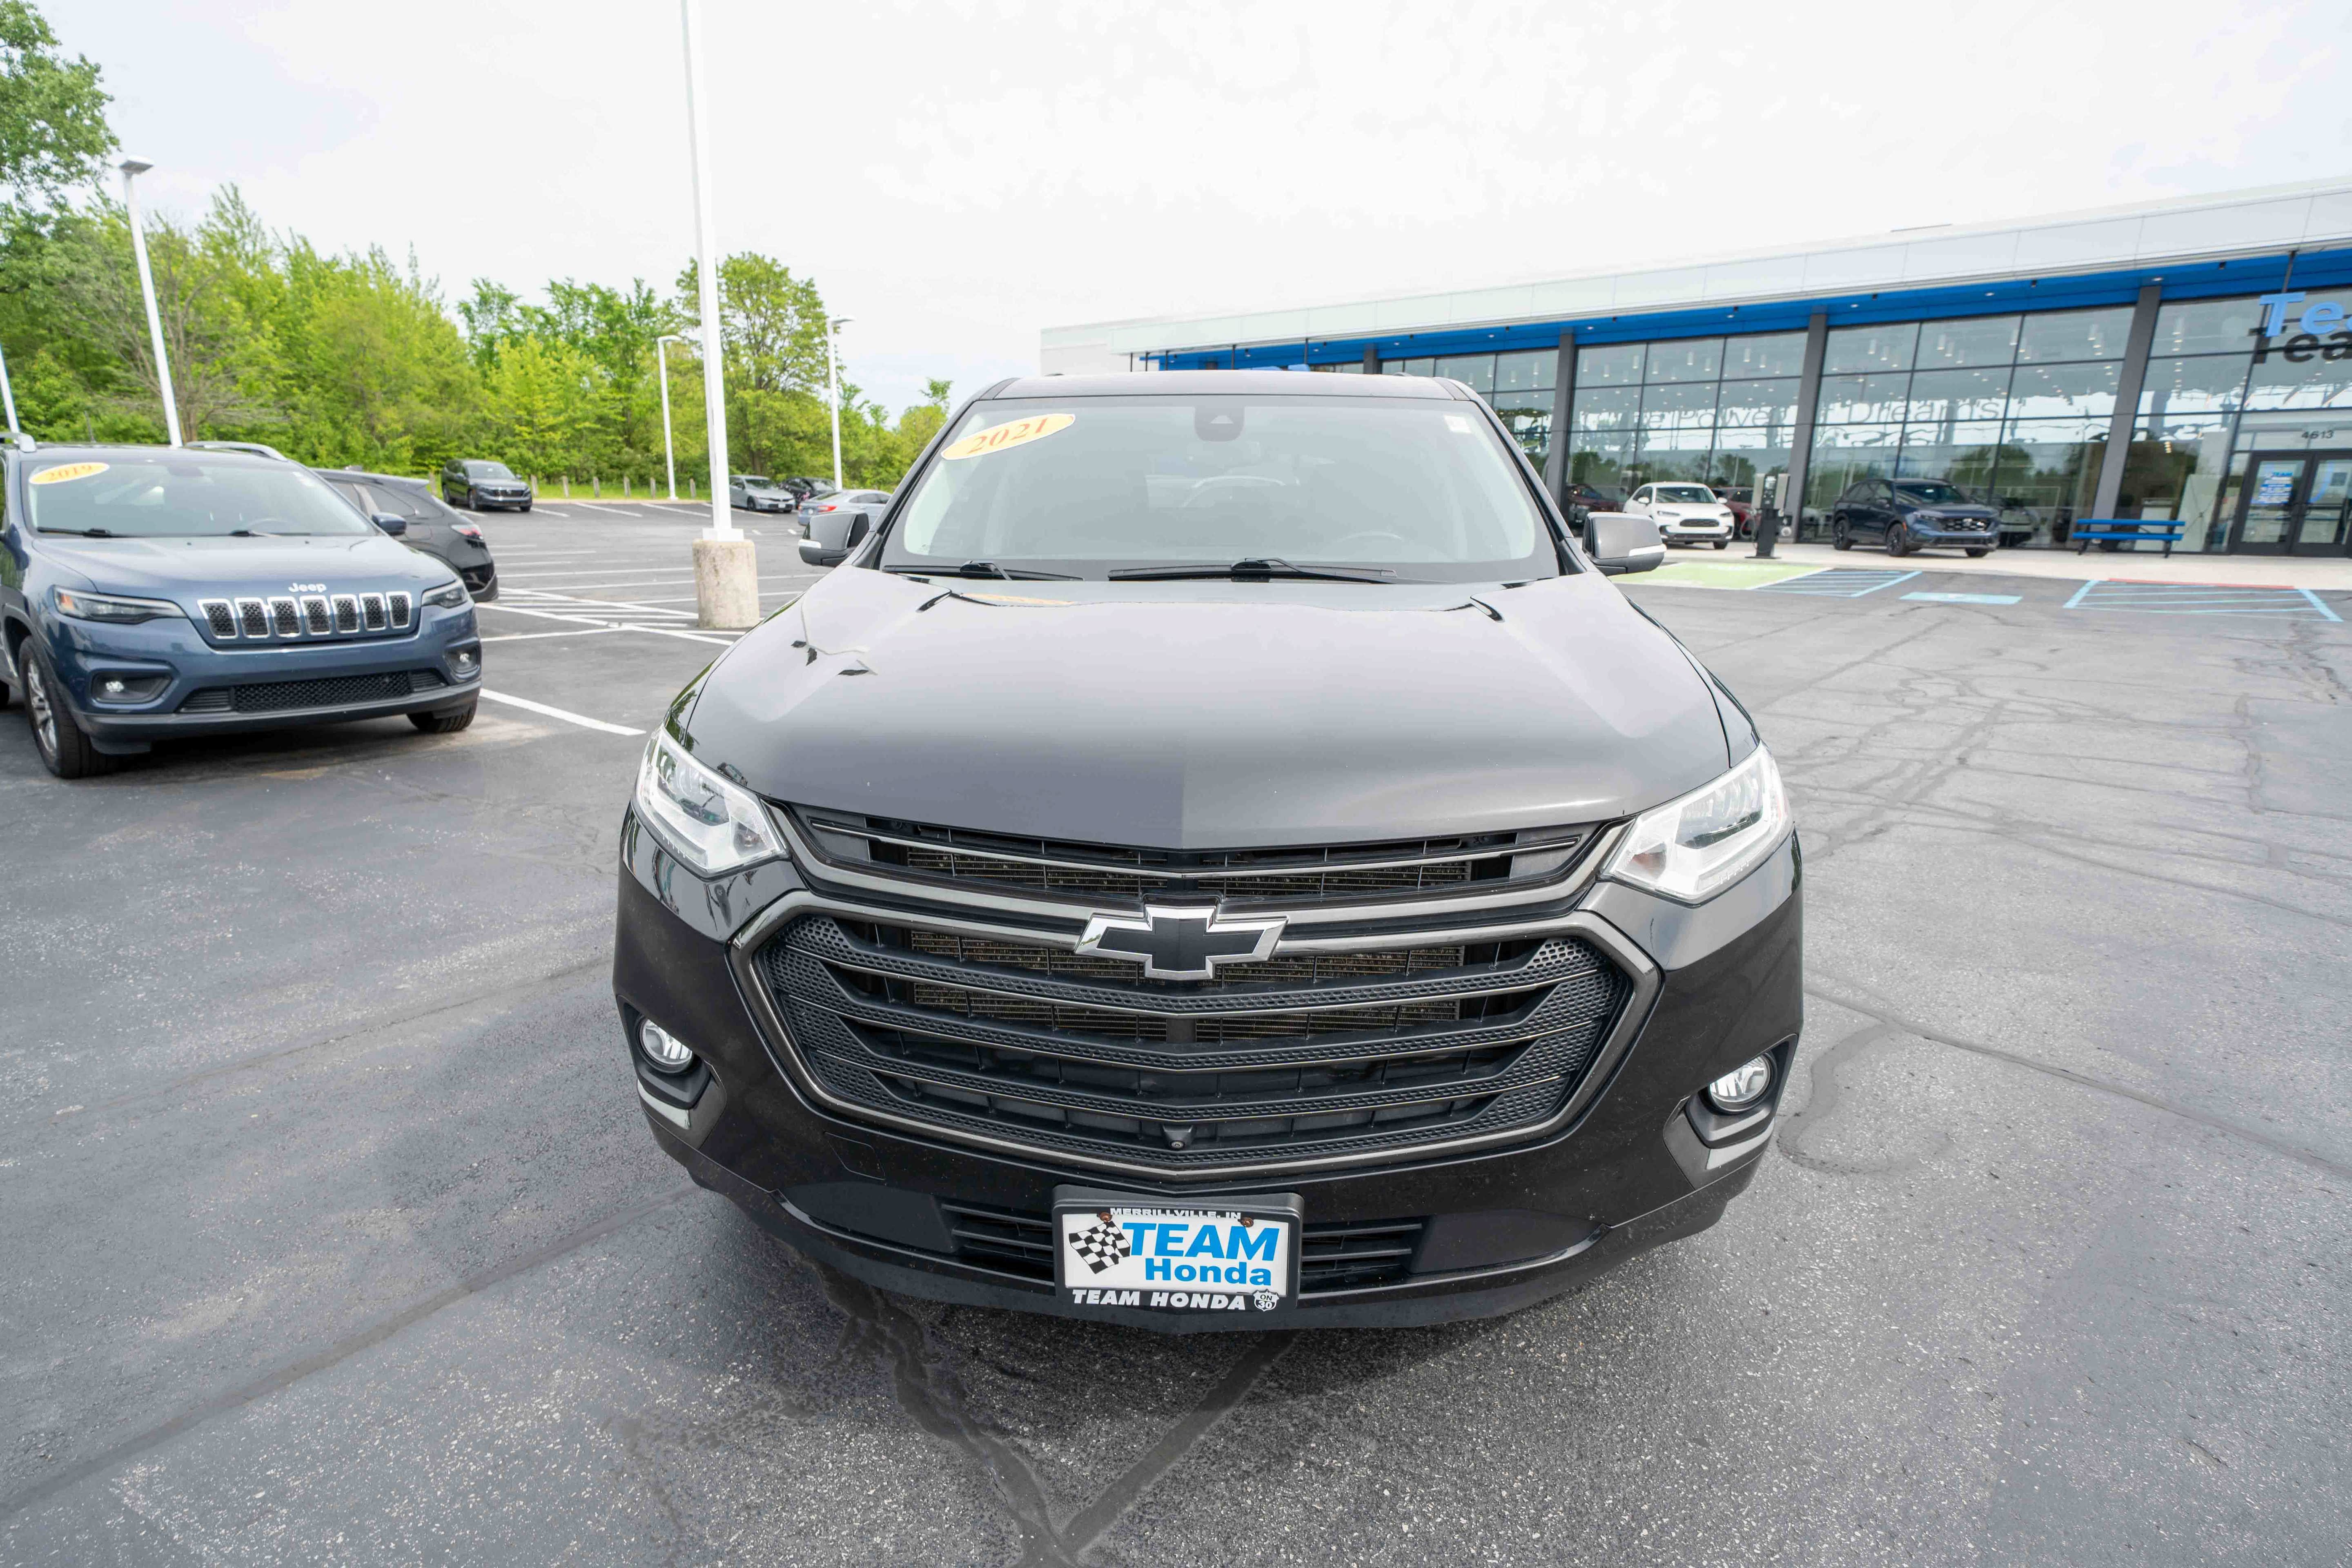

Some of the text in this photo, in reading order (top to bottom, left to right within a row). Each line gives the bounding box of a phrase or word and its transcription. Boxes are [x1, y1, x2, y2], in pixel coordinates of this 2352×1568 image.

[967, 418, 1048, 454] 2021
[2301, 430, 2334, 439] 4613
[48, 464, 92, 481] 2019
[288, 582, 326, 593] Jeep
[1123, 1222, 1279, 1261] TEAM
[1145, 1258, 1271, 1286] Honda
[1072, 1289, 1245, 1310] TEAM HONDA
[1258, 1301, 1272, 1309] 30
